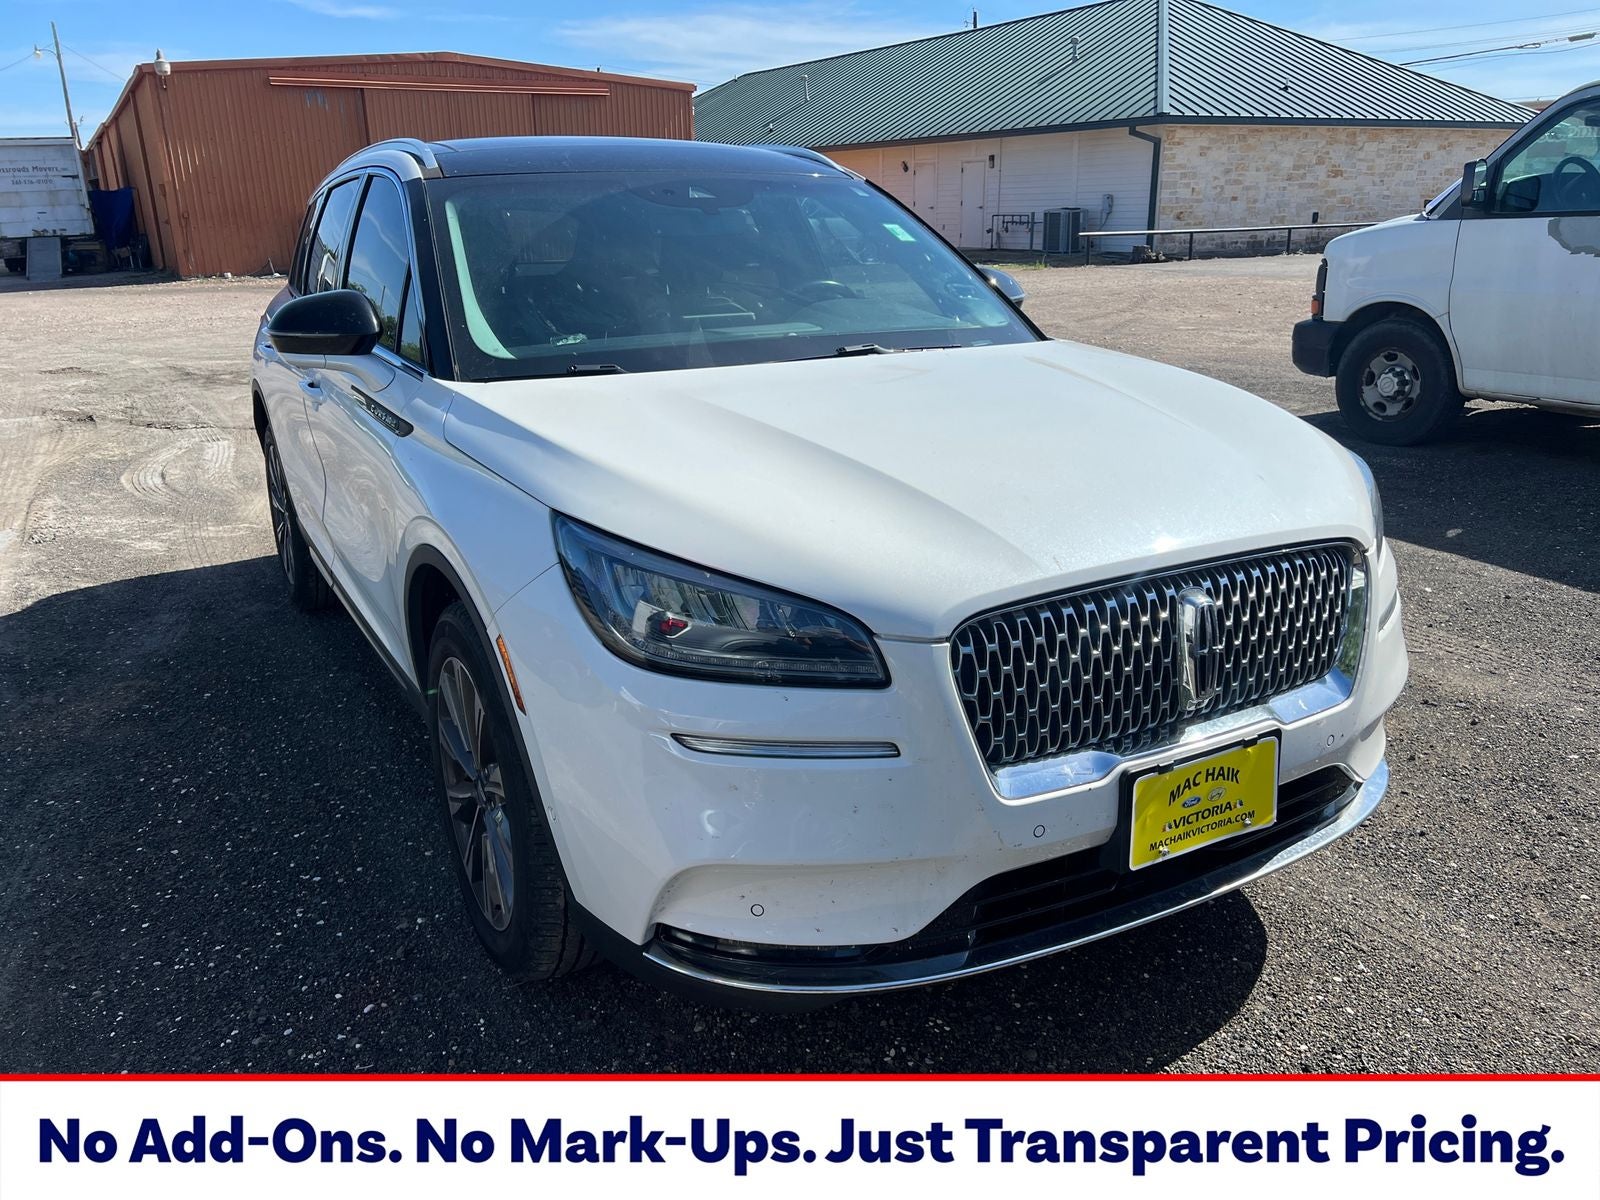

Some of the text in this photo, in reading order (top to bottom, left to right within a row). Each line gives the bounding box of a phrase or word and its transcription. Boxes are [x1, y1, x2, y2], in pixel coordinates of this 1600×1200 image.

[1168, 766, 1241, 807] MAC HAIK
[1149, 810, 1256, 852] MACHAIKVICTORIA.COM
[1172, 801, 1233, 830] VICTORIA
